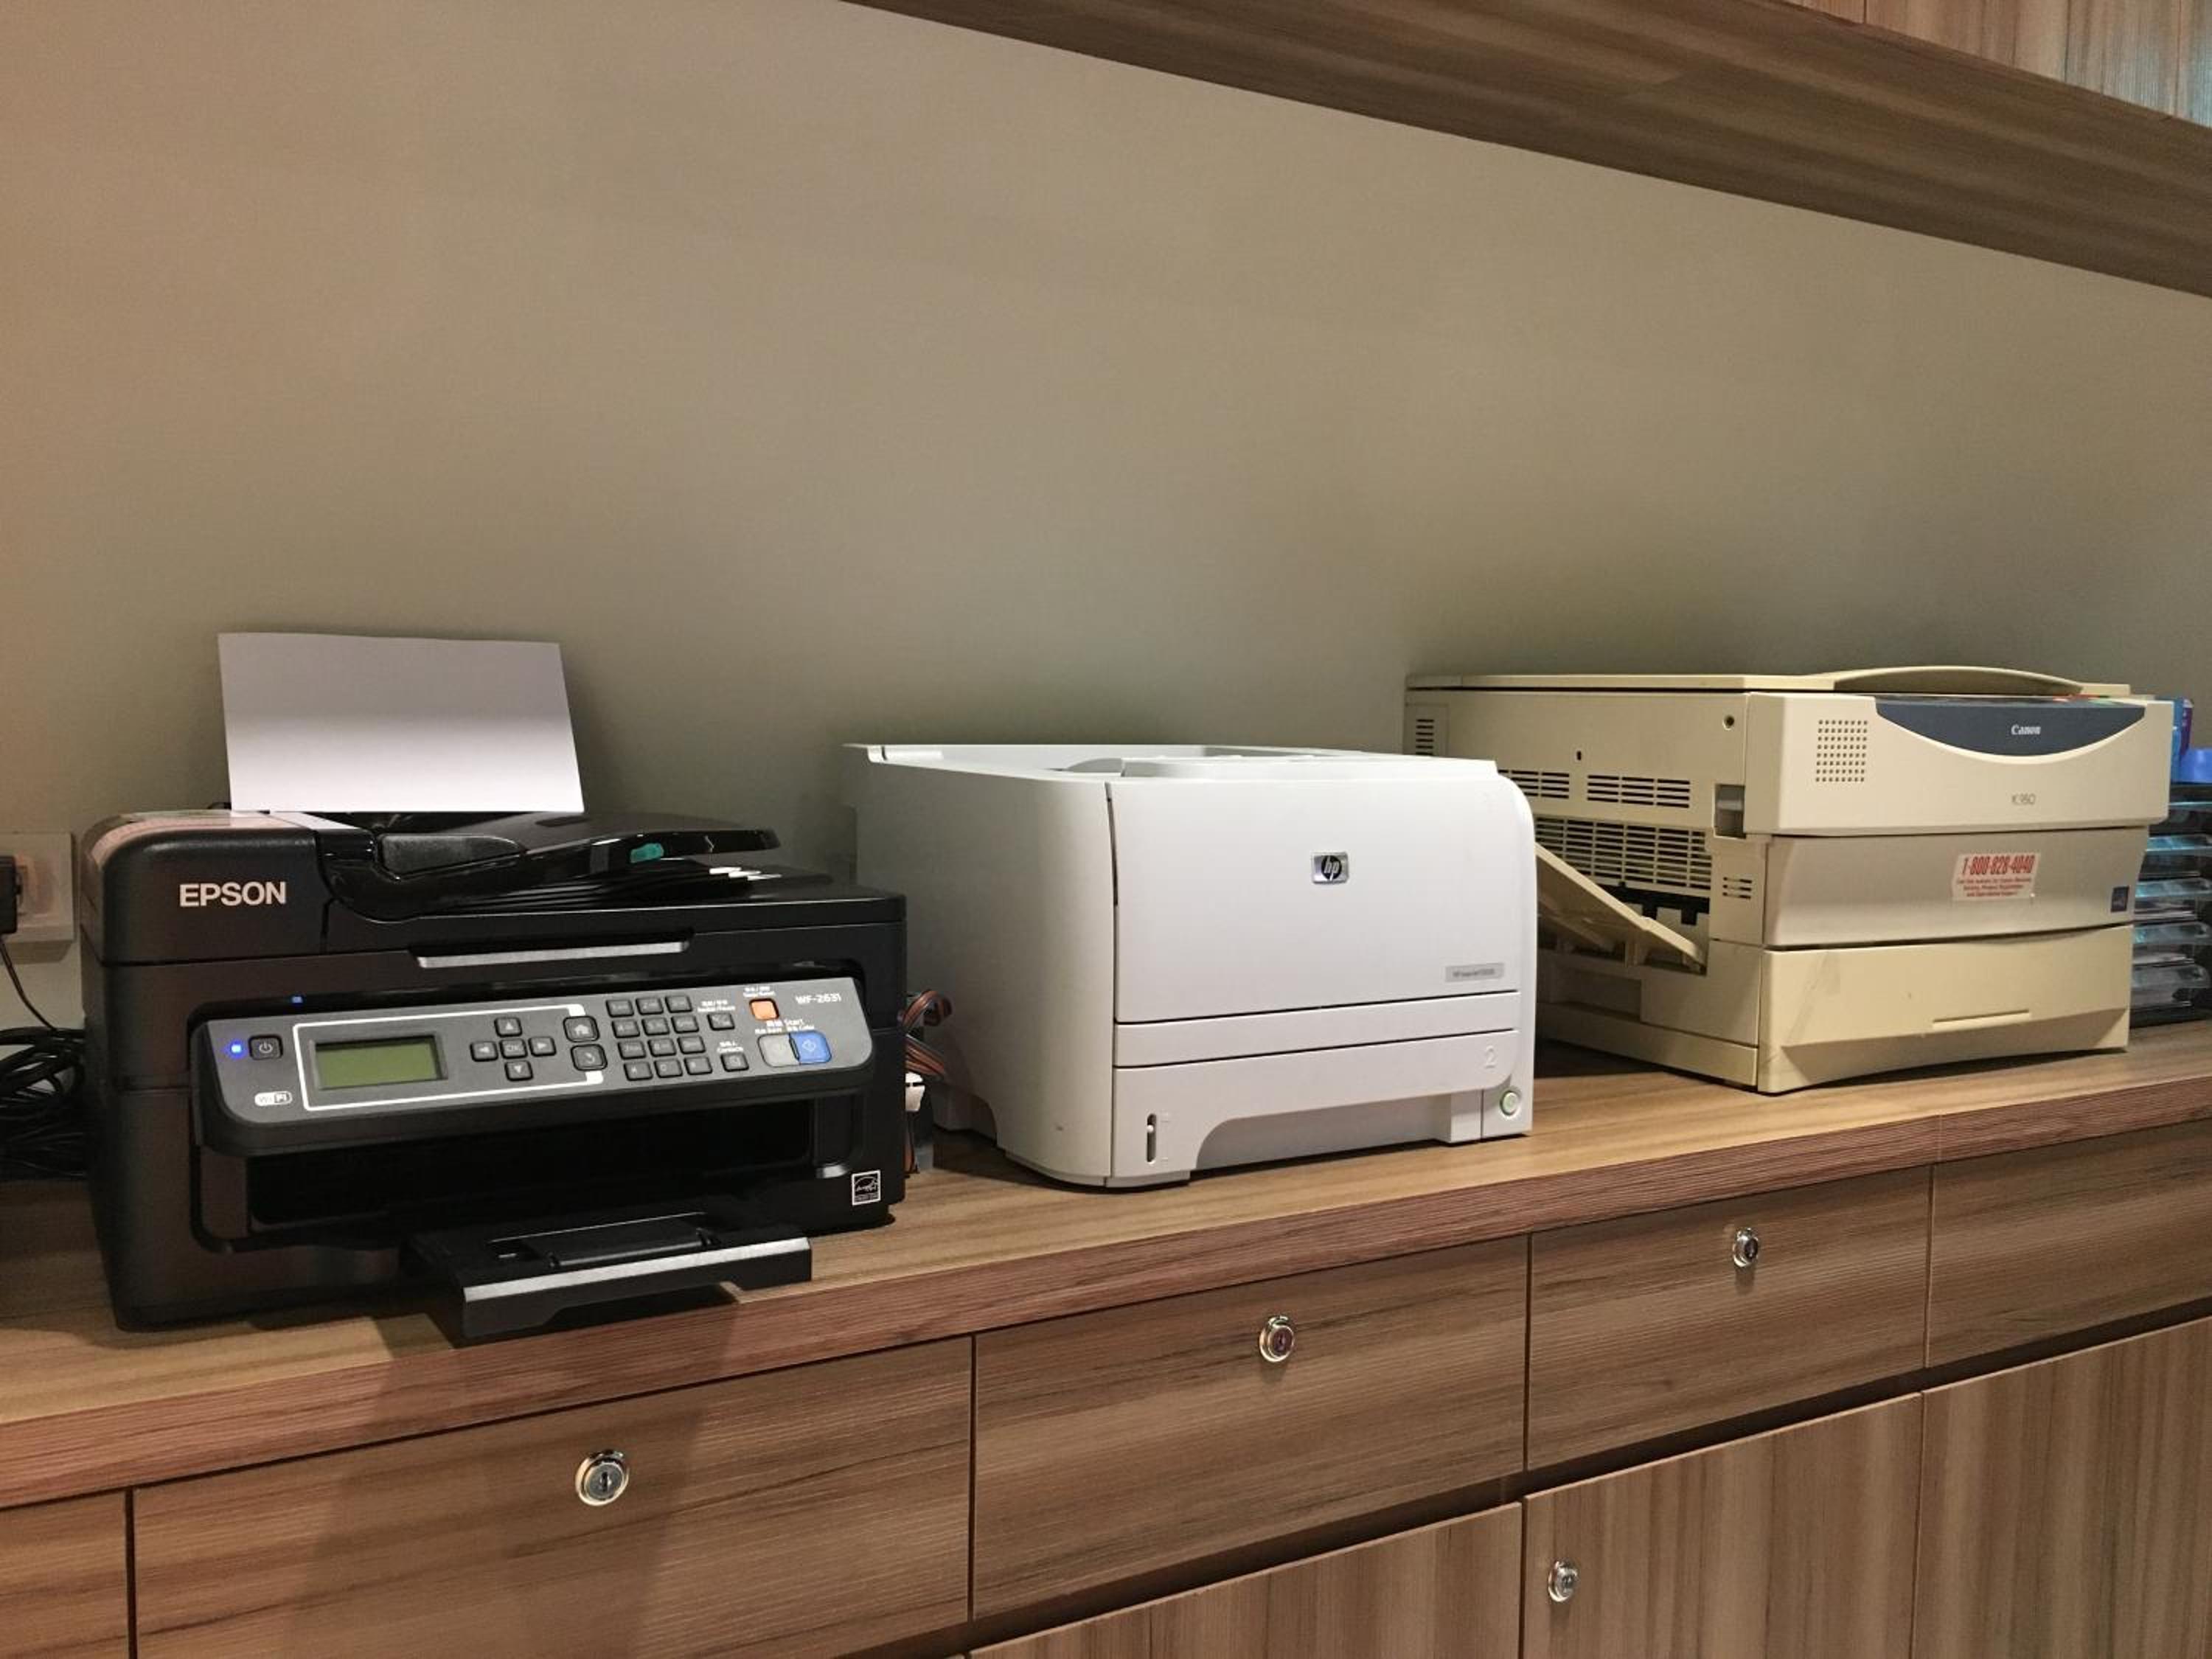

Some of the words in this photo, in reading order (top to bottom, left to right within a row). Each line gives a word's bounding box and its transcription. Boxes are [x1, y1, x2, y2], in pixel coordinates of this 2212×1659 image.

[2011, 724, 2041, 736] Canon
[1324, 856, 1340, 880] hp
[179, 881, 287, 908] EPSON
